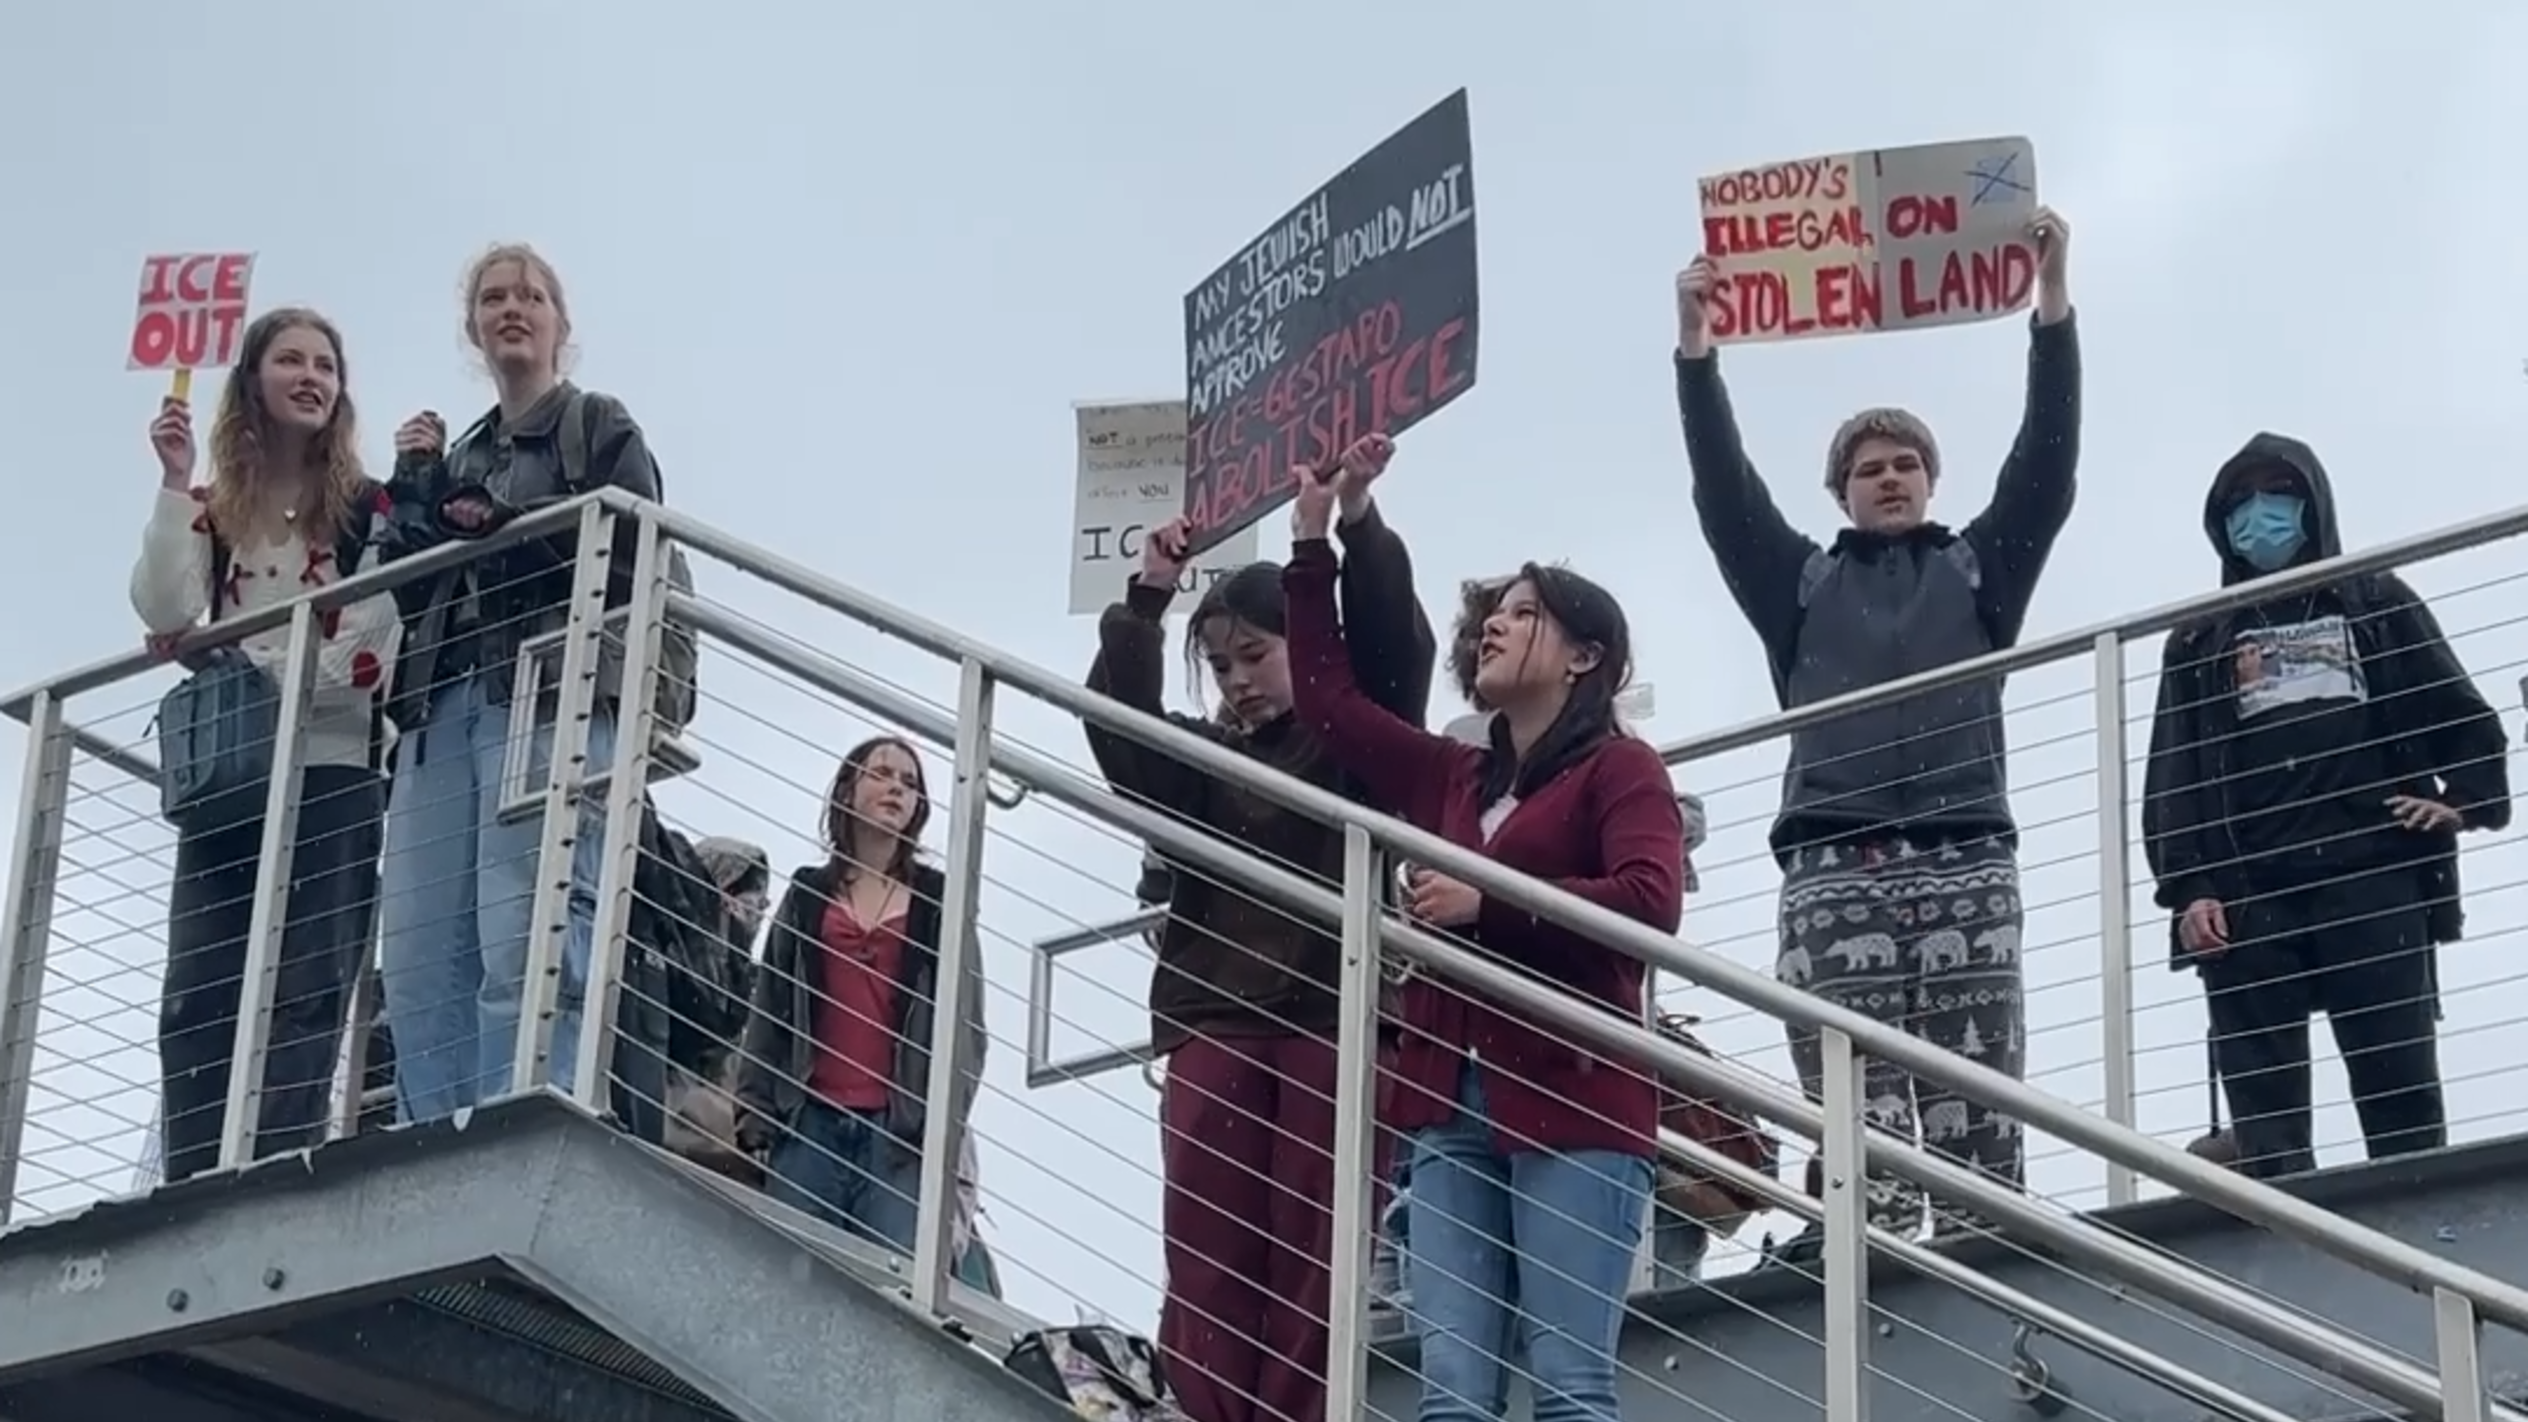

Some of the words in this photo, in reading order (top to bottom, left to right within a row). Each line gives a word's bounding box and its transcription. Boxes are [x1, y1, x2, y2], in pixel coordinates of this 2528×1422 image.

[1700, 157, 1849, 207] NOBODY'S
[1703, 205, 1874, 257] ILLEGAL
[1886, 195, 1958, 238] ON
[140, 254, 250, 305] ICE
[1191, 249, 1325, 378] ANCESTORS
[1333, 204, 1404, 279] WOULD
[1407, 163, 1466, 245] NOT
[1194, 270, 1231, 331] MY
[1239, 191, 1330, 297] JEWISH
[1710, 262, 1882, 336] STOLEN
[1901, 243, 2036, 319] LAND
[132, 306, 245, 367] OUT
[1189, 320, 1288, 421] APPROVE
[1087, 430, 1119, 447] NOT
[1191, 379, 1356, 535] ABOLISH
[1365, 316, 1466, 434] ICE
[1138, 482, 1170, 499] YOU
[1081, 524, 1144, 561] IC
[1176, 565, 1226, 594] UT
